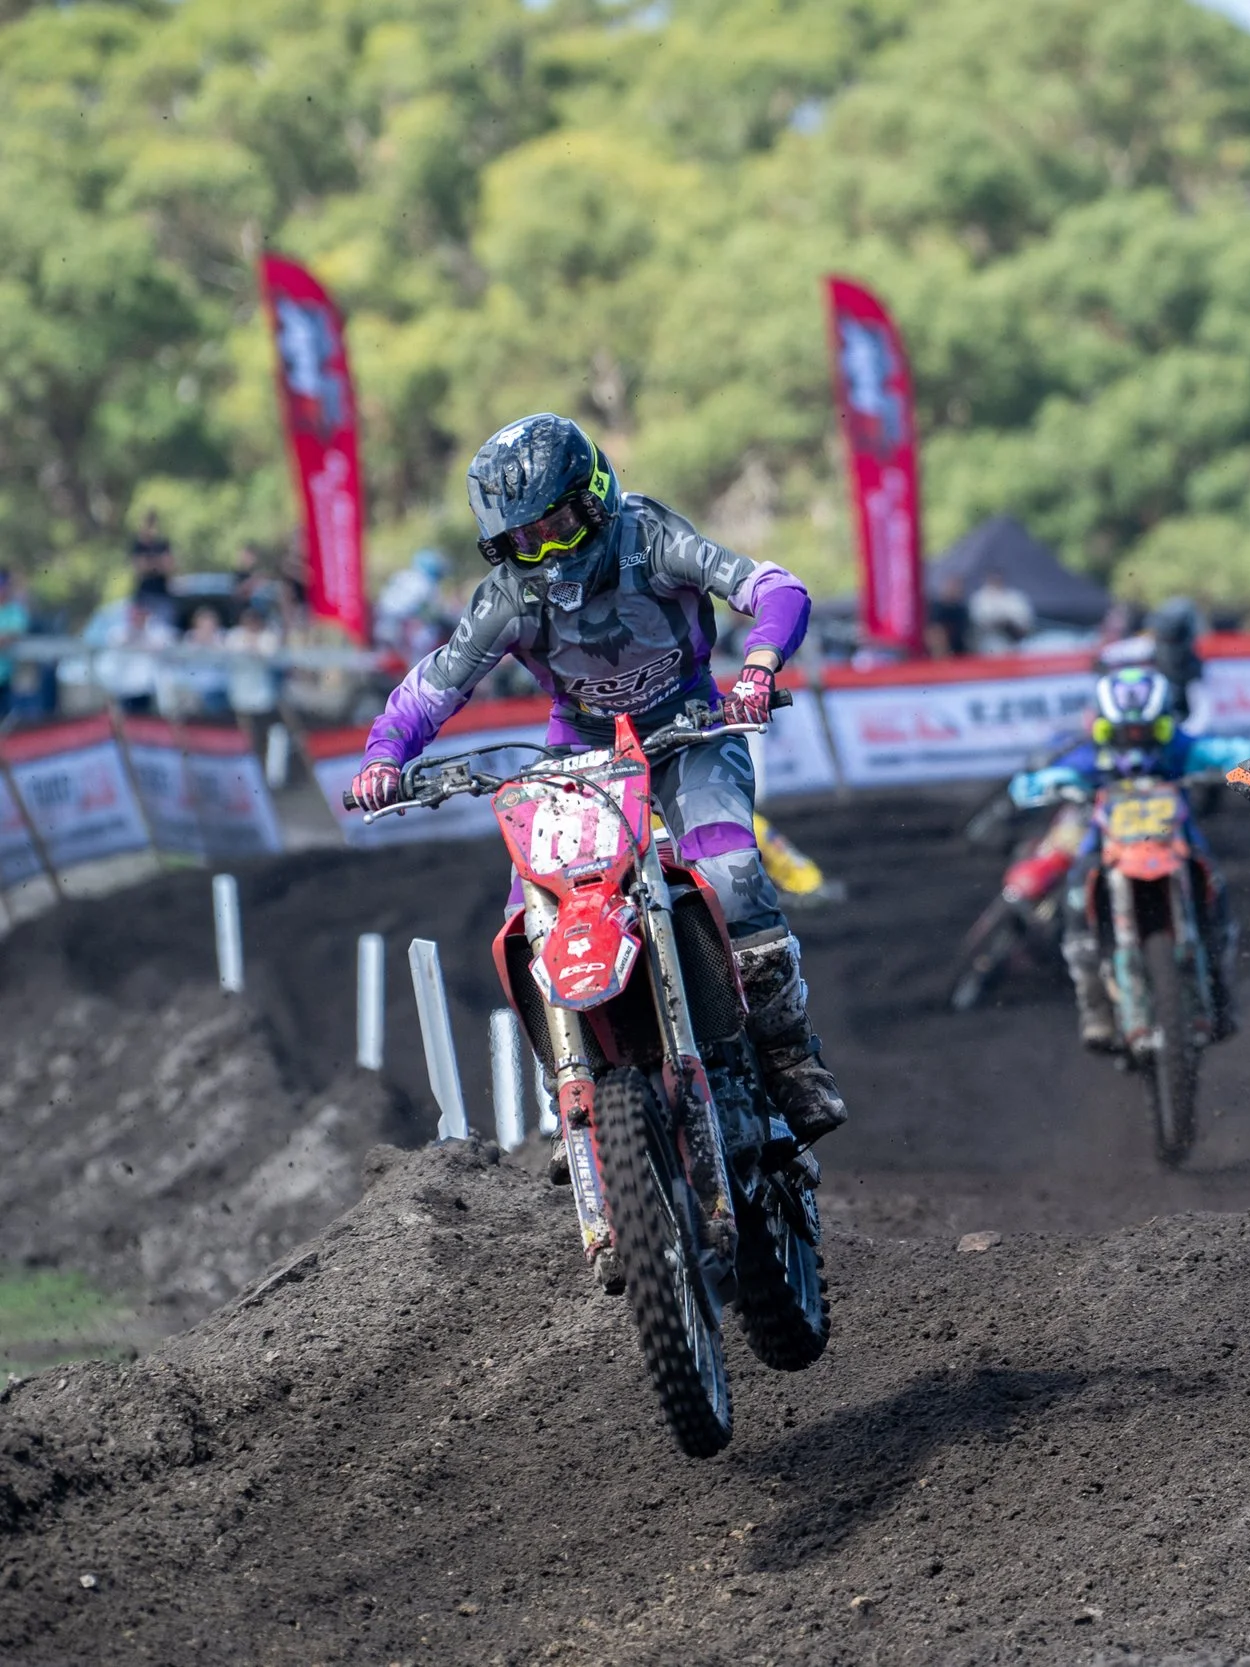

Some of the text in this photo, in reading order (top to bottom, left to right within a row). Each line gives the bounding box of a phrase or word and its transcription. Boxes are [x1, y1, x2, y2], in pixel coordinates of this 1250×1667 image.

[582, 501, 602, 523] FOX
[483, 539, 501, 564] FOX
[665, 531, 740, 584] FOX
[439, 599, 493, 671] FOX
[708, 743, 754, 784] FO
